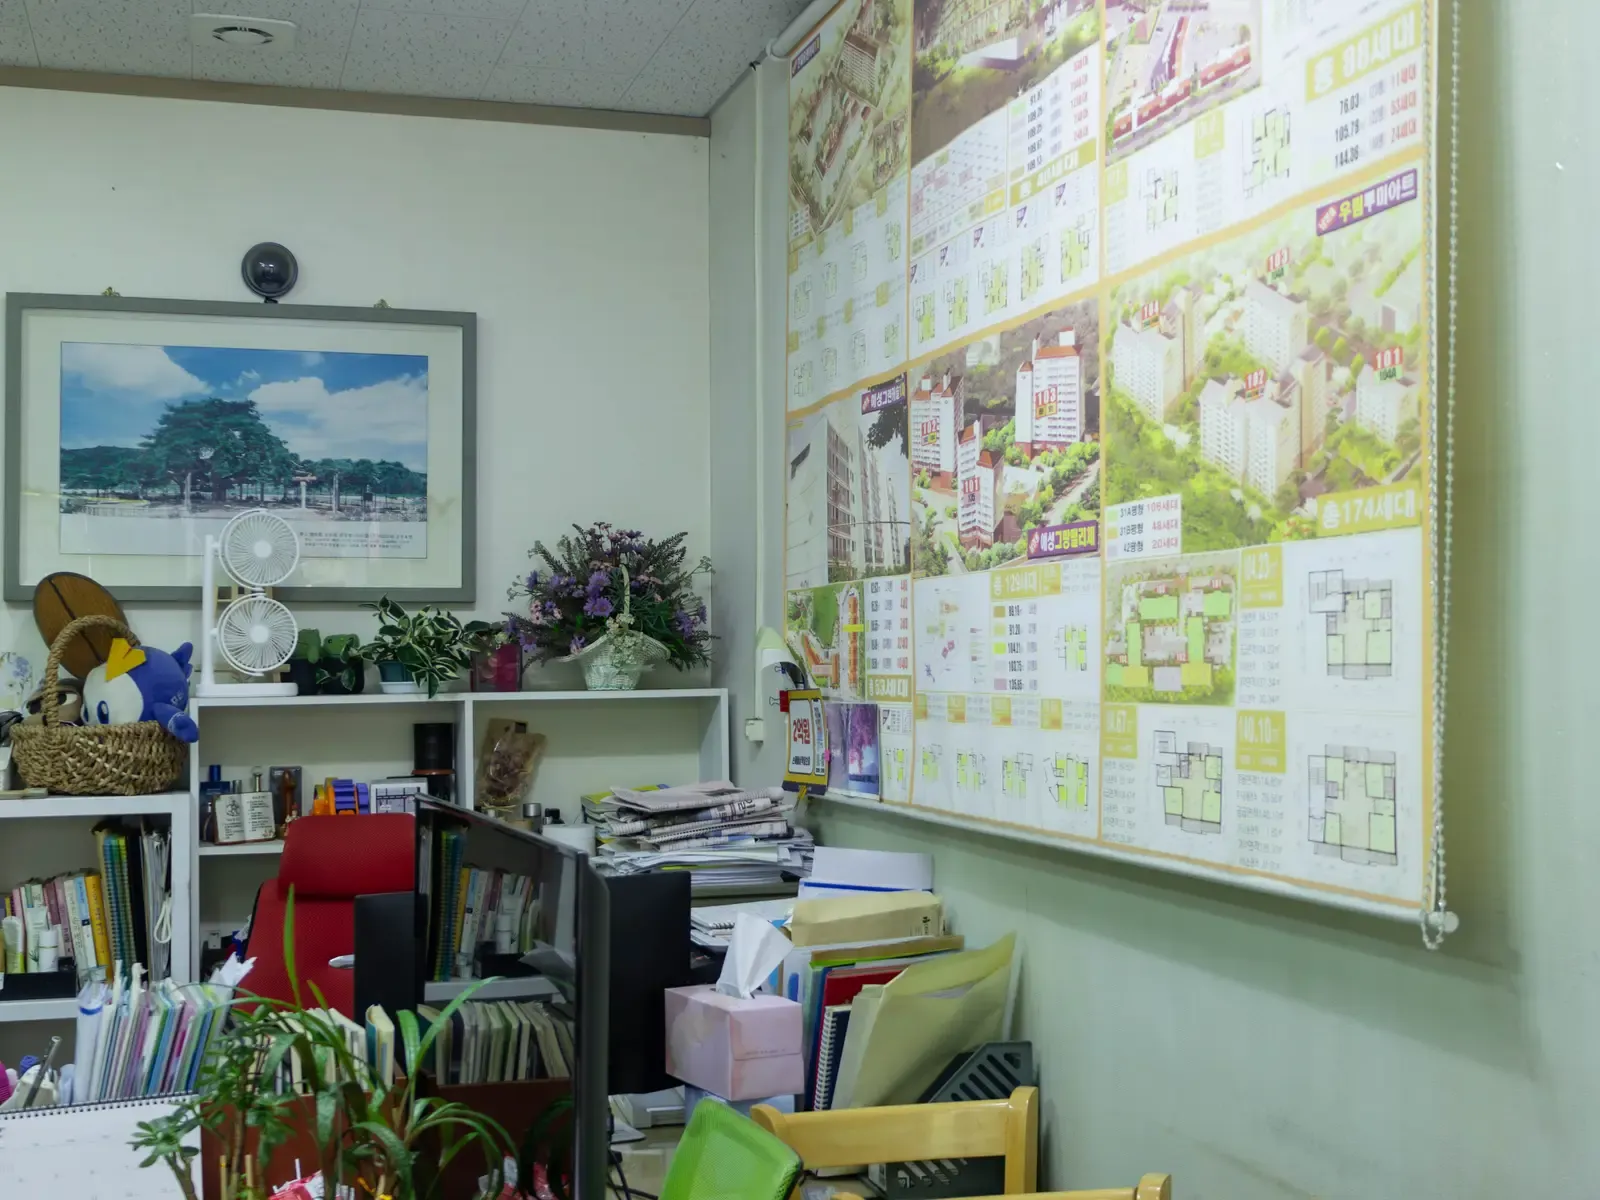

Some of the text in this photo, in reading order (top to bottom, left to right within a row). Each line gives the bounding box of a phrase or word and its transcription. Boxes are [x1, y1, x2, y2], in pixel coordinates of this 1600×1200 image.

[1339, 92, 1360, 115] 76.03
[1375, 347, 1400, 368] 101
[1037, 386, 1056, 406] 103
[922, 420, 937, 435] 102
[964, 477, 979, 493] 101
[793, 718, 811, 744] 2억원
